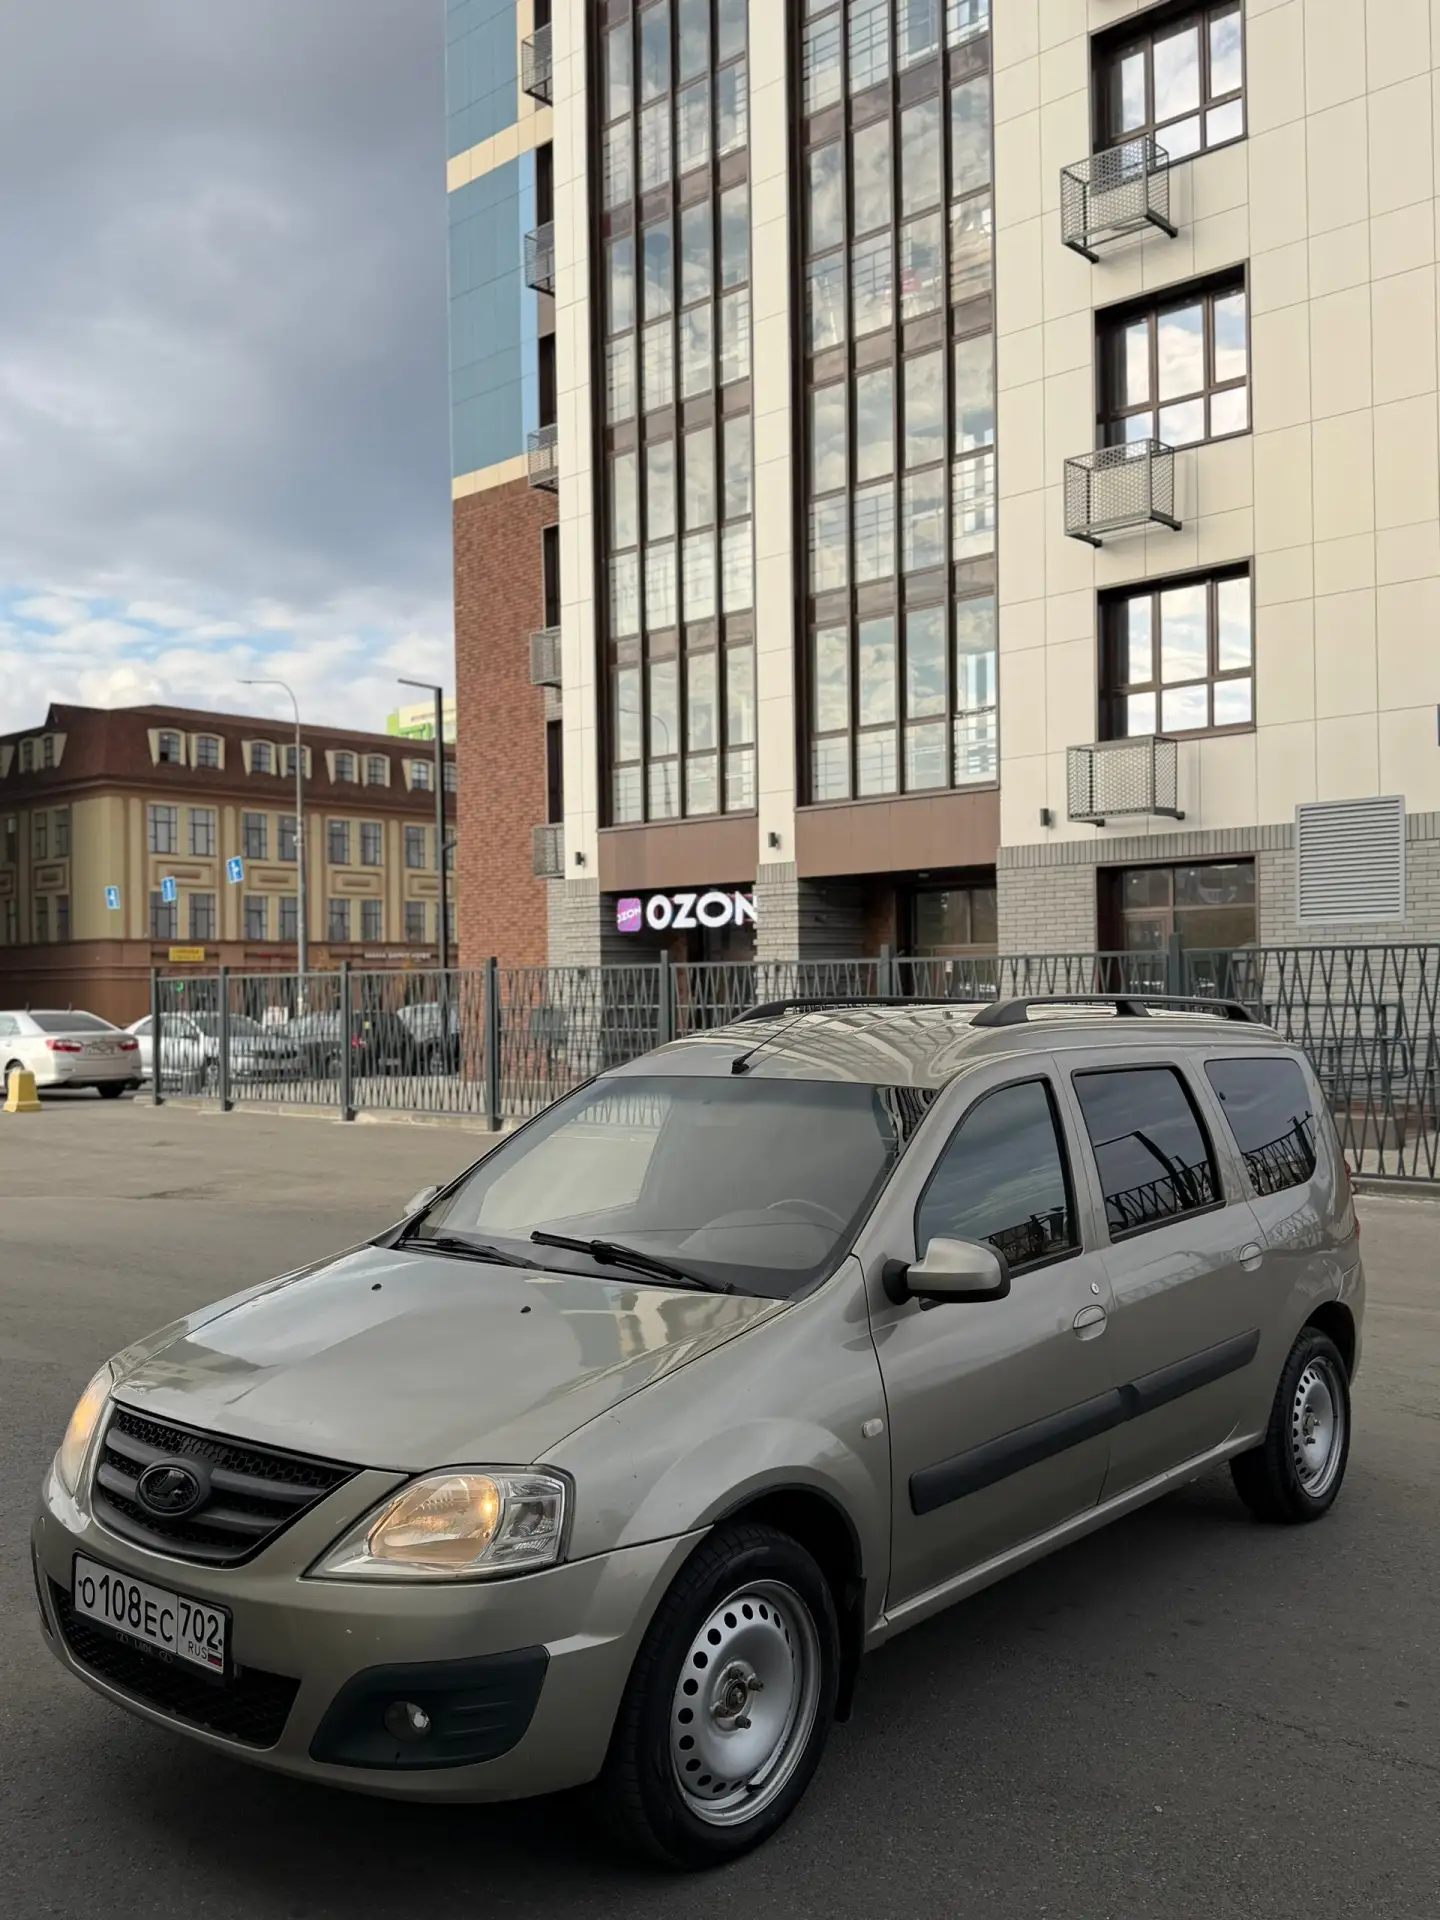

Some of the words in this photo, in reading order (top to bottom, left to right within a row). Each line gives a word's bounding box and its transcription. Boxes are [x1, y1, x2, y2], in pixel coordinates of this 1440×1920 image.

[646, 891, 757, 930] OZON
[180, 1602, 219, 1650] 702
[188, 1641, 208, 1659] RUS
